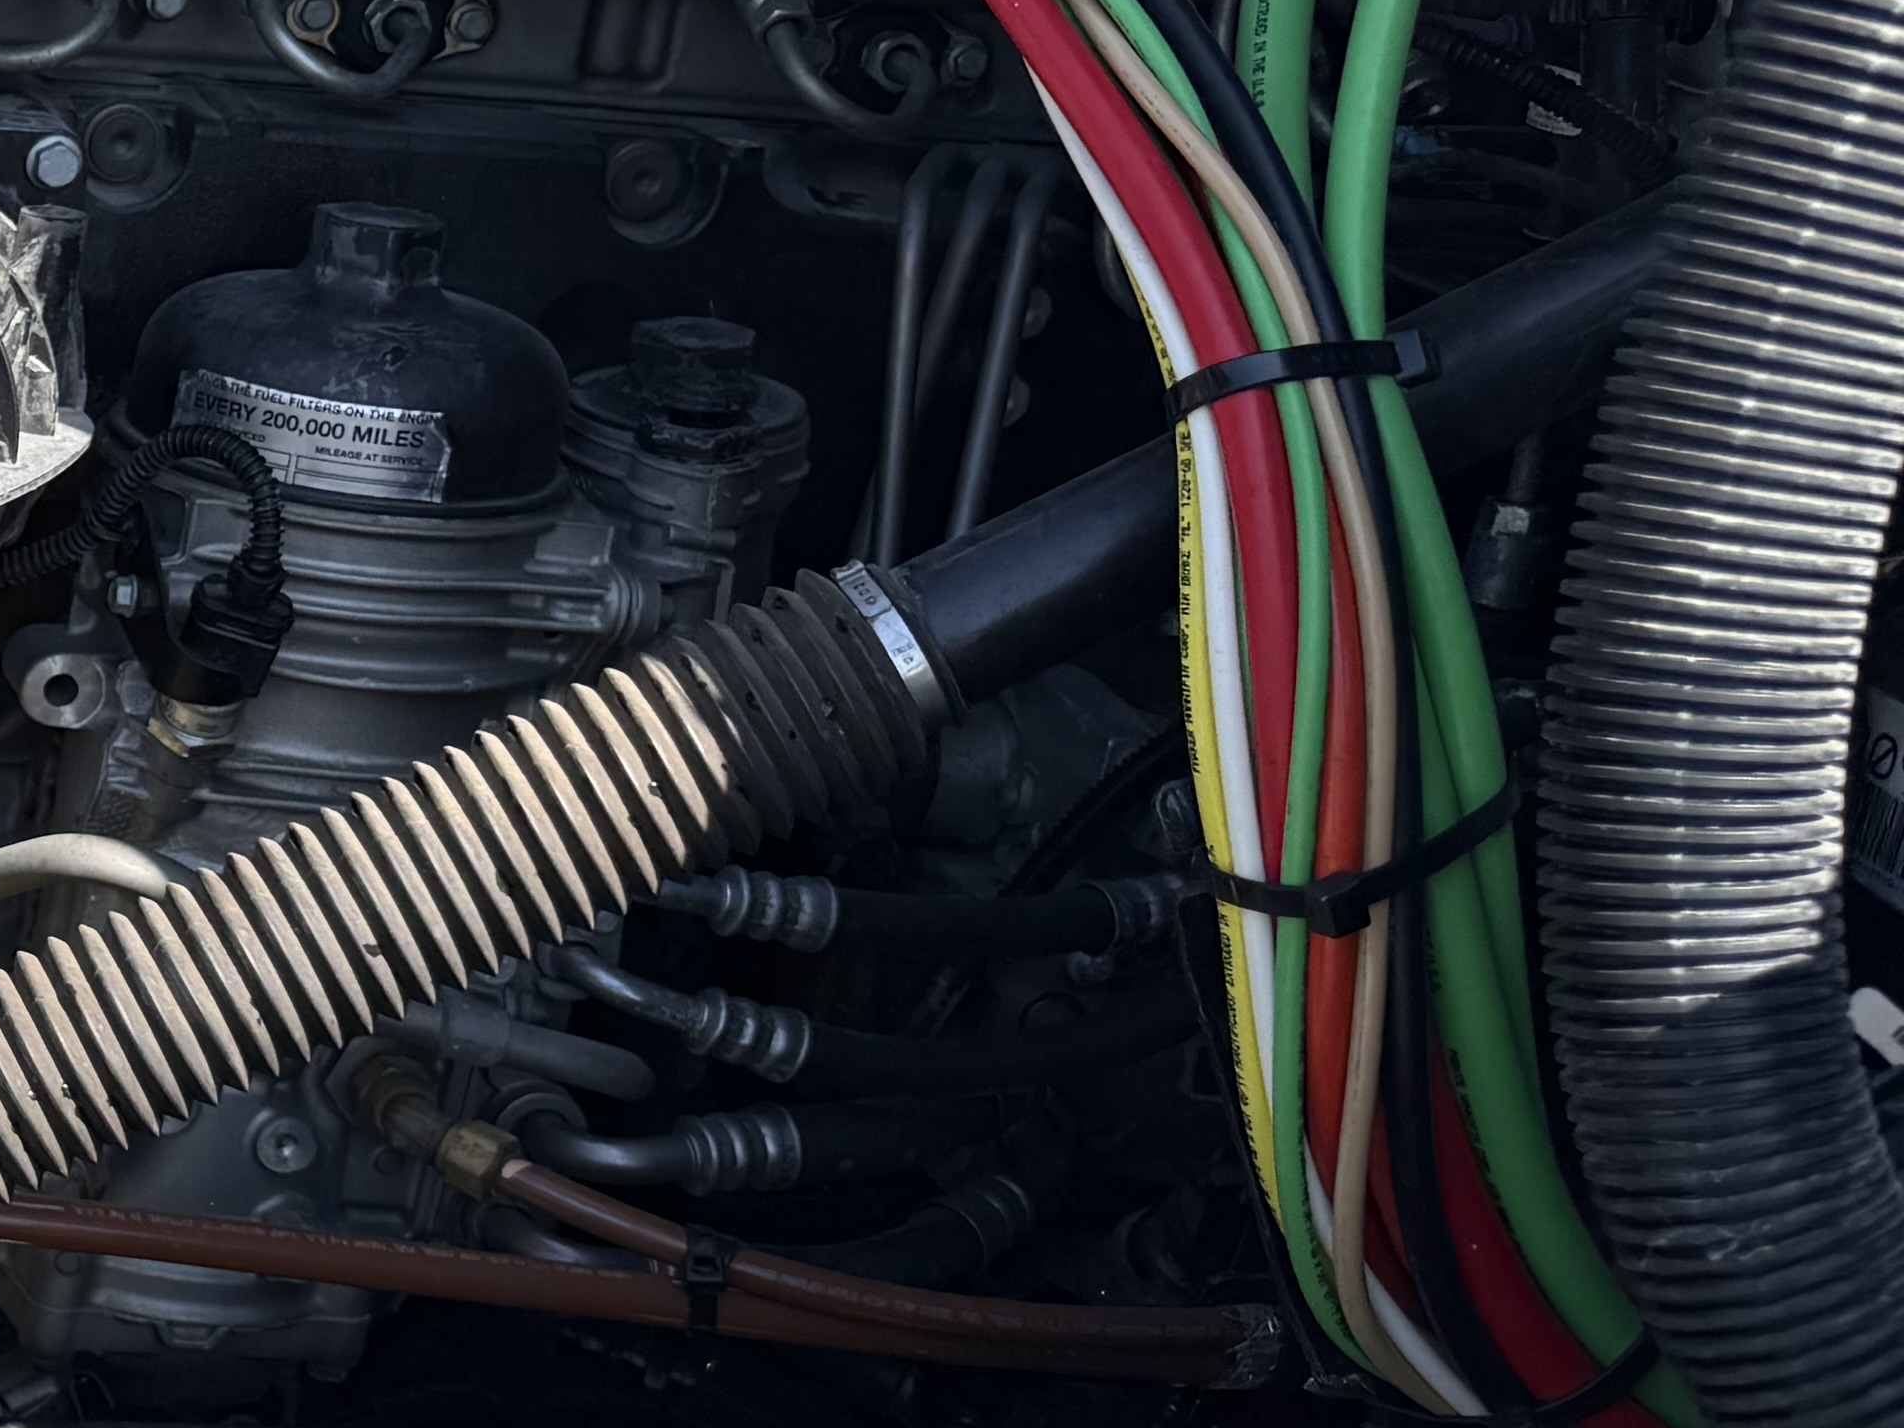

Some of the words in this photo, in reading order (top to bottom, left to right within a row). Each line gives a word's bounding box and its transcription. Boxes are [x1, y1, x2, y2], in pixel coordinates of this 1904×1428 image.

[194, 390, 257, 423] EVERY
[261, 410, 345, 440] 200,000
[351, 425, 425, 449] MILES
[254, 389, 286, 407] FUEL
[288, 396, 341, 416] FILTERS
[344, 405, 365, 419] ON
[369, 409, 395, 422] THE
[315, 445, 362, 460] MILEAGE
[364, 452, 379, 463] AT
